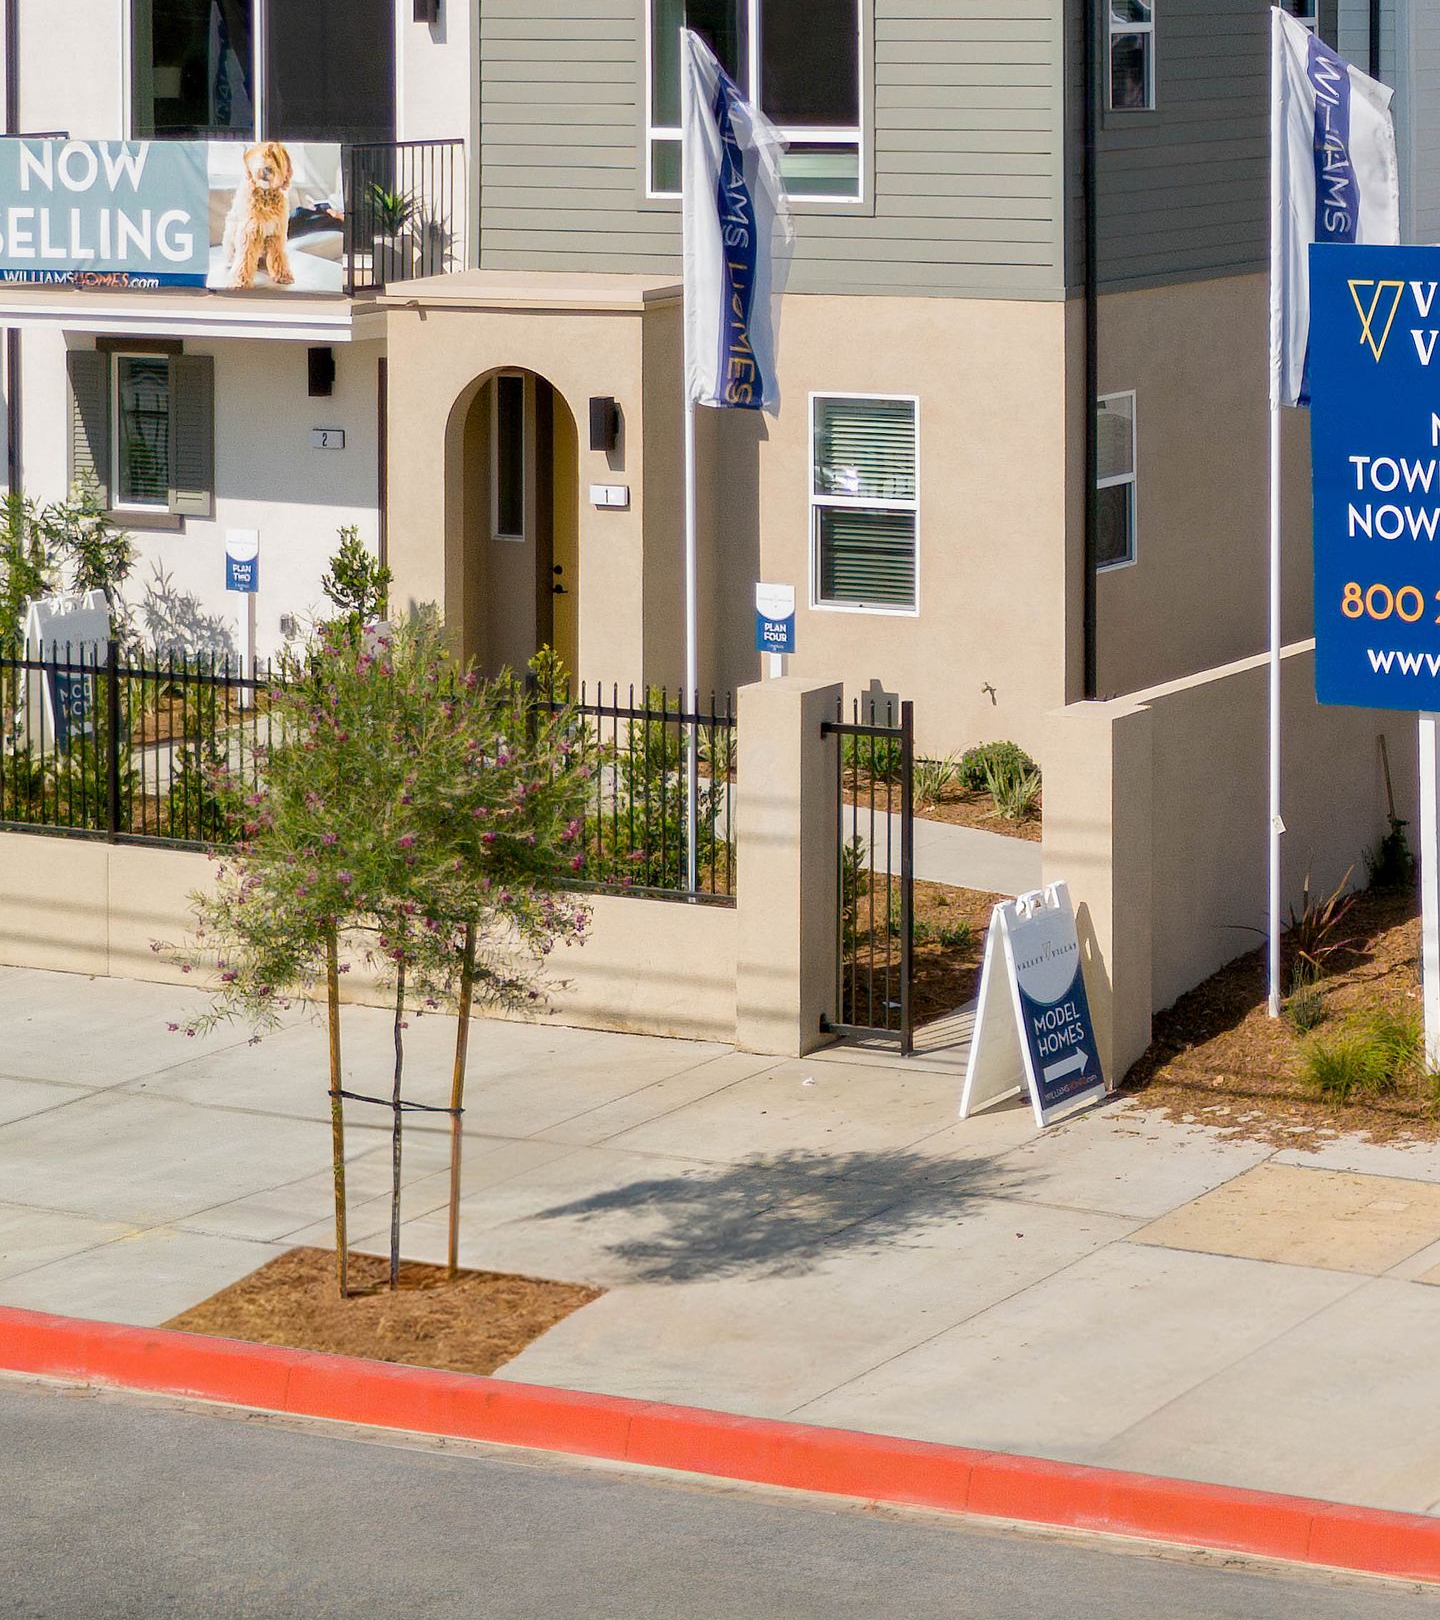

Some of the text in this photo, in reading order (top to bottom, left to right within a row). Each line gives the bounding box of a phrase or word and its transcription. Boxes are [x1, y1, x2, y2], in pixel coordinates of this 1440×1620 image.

[19, 141, 148, 192] NOW
[322, 432, 328, 447] 2
[1341, 582, 1425, 623] 800
[764, 622, 786, 632] PLAN
[764, 631, 787, 642] FOUR
[1033, 1001, 1081, 1036] MODEL
[1037, 1021, 1085, 1058] HOMES
